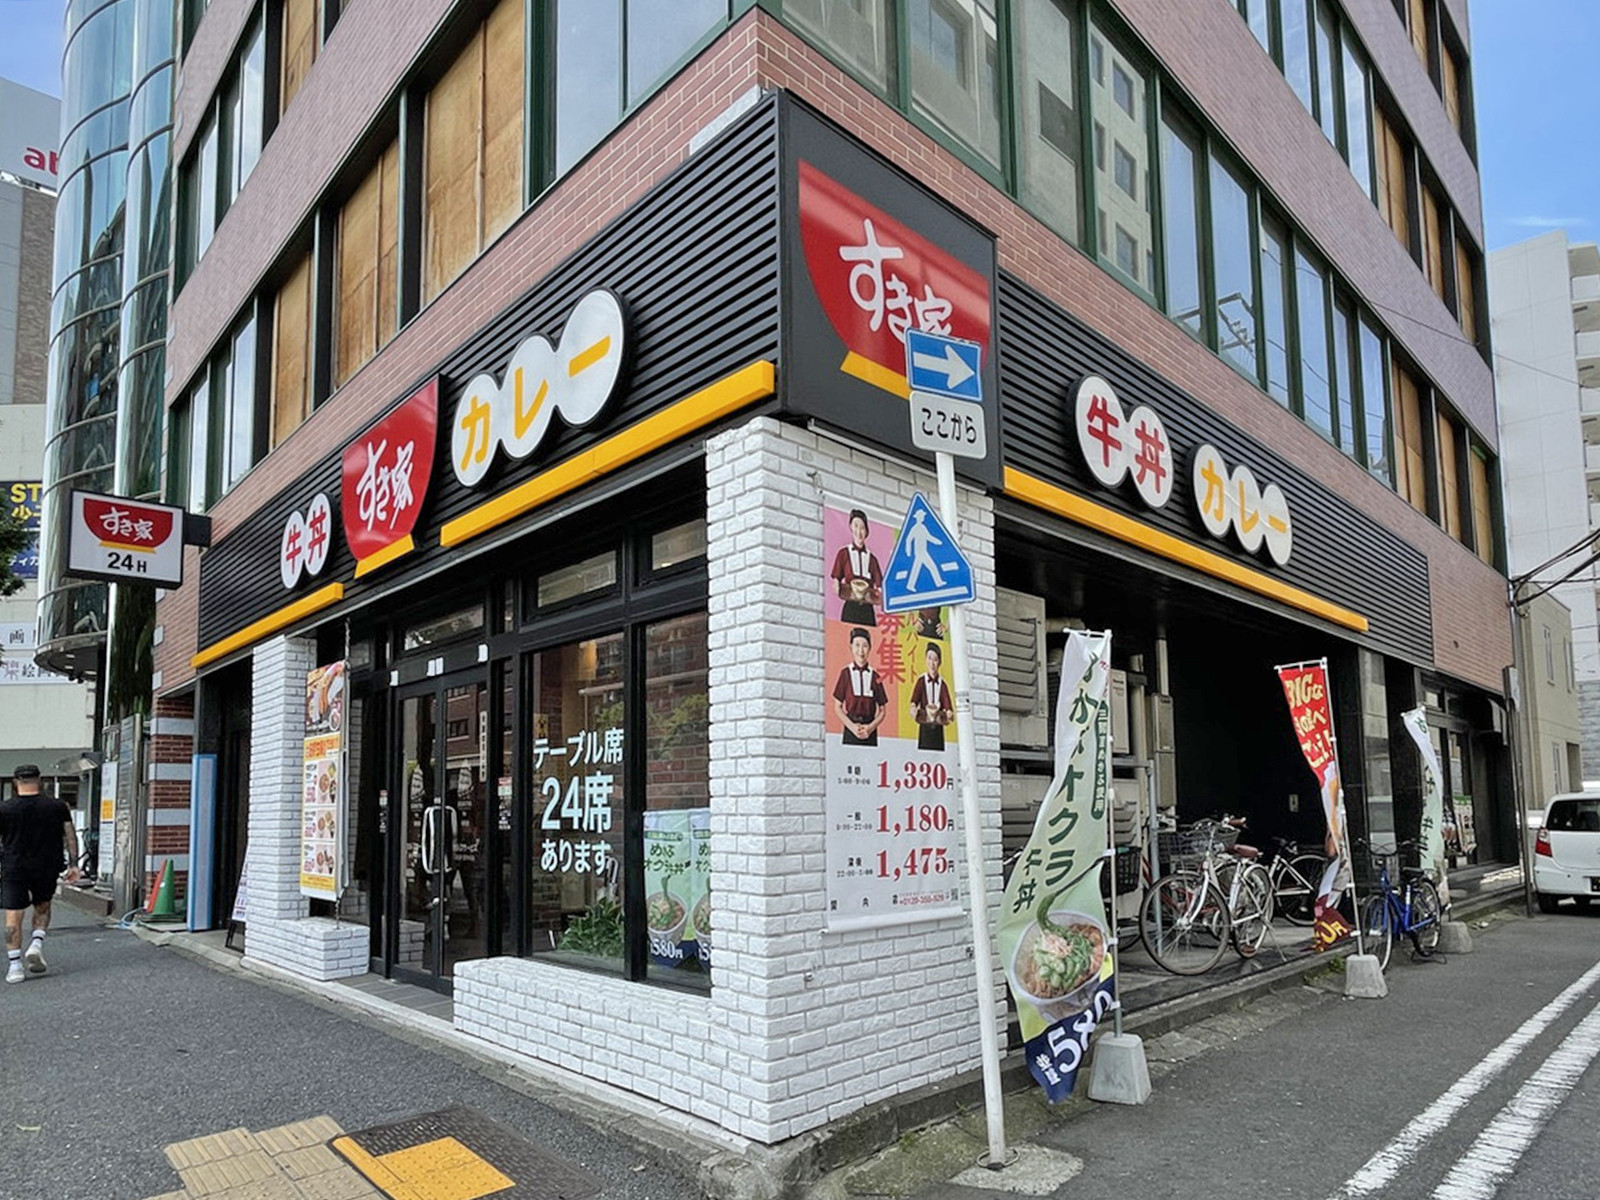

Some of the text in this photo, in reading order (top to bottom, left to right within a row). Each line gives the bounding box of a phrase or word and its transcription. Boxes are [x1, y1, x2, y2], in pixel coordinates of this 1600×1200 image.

[461, 335, 611, 471] カレー
[922, 408, 977, 444] ここから
[1087, 394, 1166, 494] 牛丼
[356, 439, 415, 531] すき家
[1200, 459, 1287, 534] カレー
[100, 506, 153, 542] すき家
[286, 505, 327, 574] 牛丼
[533, 727, 624, 770] テーブル席
[541, 771, 614, 834] 24席
[541, 839, 612, 876] あります
